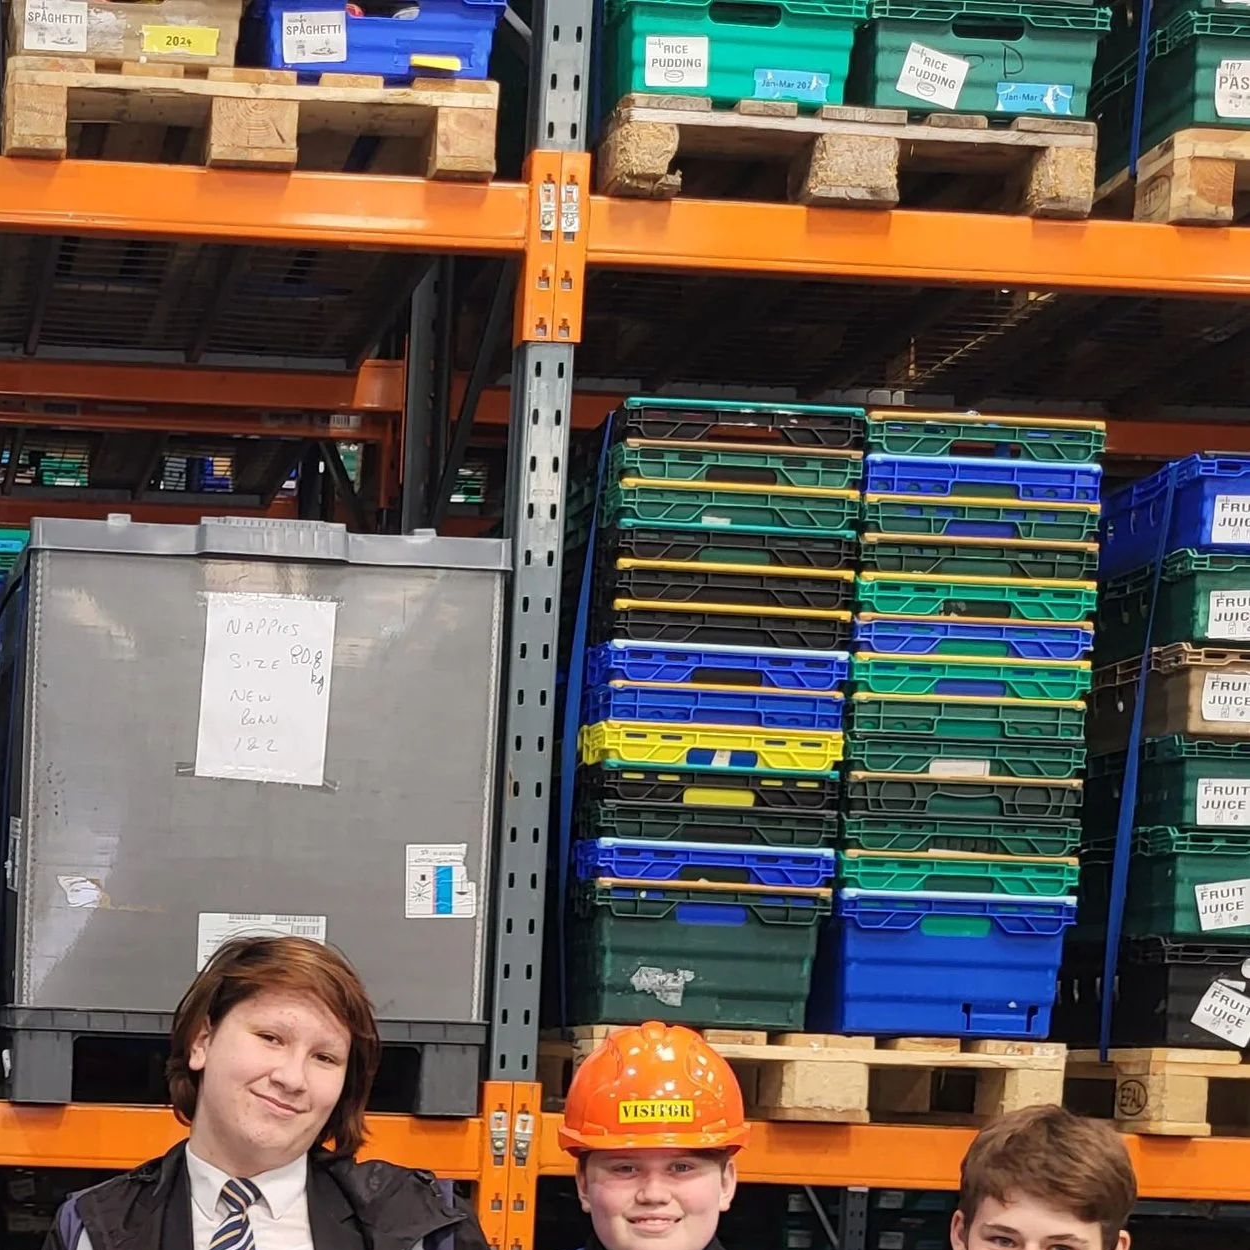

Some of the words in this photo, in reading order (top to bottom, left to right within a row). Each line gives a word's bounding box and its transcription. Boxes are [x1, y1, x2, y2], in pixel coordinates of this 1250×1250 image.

[28, 12, 83, 25] SPAGHETTI
[286, 24, 342, 36] SPAGHETTI
[165, 35, 192, 48] 2024
[663, 44, 689, 55] RICE
[651, 58, 702, 69] PUDDING
[923, 56, 949, 73] RICE
[761, 79, 795, 89] Jan-Mar
[908, 65, 957, 91] PUDDING
[1004, 92, 1038, 102] Jan-Mar
[229, 653, 281, 670] SIZE
[1211, 681, 1250, 692] FRUI
[230, 689, 272, 703] NEW
[266, 738, 280, 752] 2
[1204, 786, 1250, 796] FRUIT
[1201, 800, 1247, 810] JUICE
[1200, 886, 1246, 901] FRUIT
[1201, 901, 1245, 915] JUICE
[1203, 1003, 1246, 1029] JUICE
[622, 1104, 691, 1118] VISITOR
